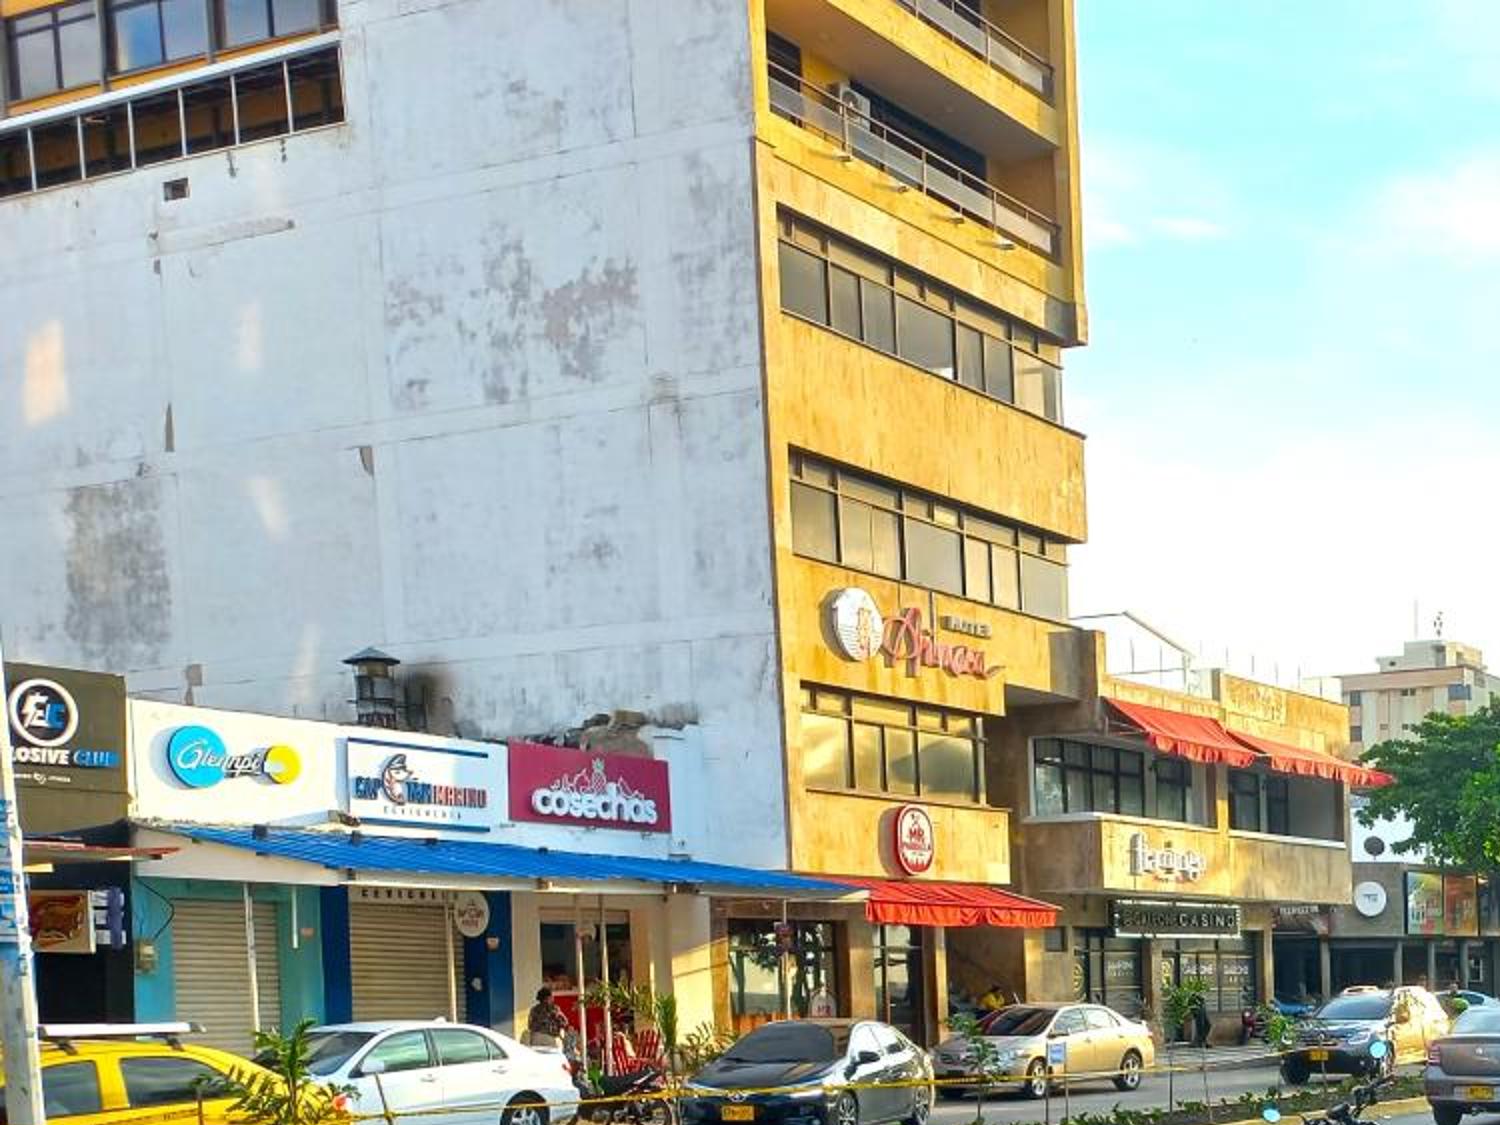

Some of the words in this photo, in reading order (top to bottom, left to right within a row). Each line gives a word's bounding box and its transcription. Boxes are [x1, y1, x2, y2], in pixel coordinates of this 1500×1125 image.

[9, 745, 70, 766] LOSIVE
[531, 782, 658, 824] cosechas
[1179, 912, 1235, 928] CASINO
